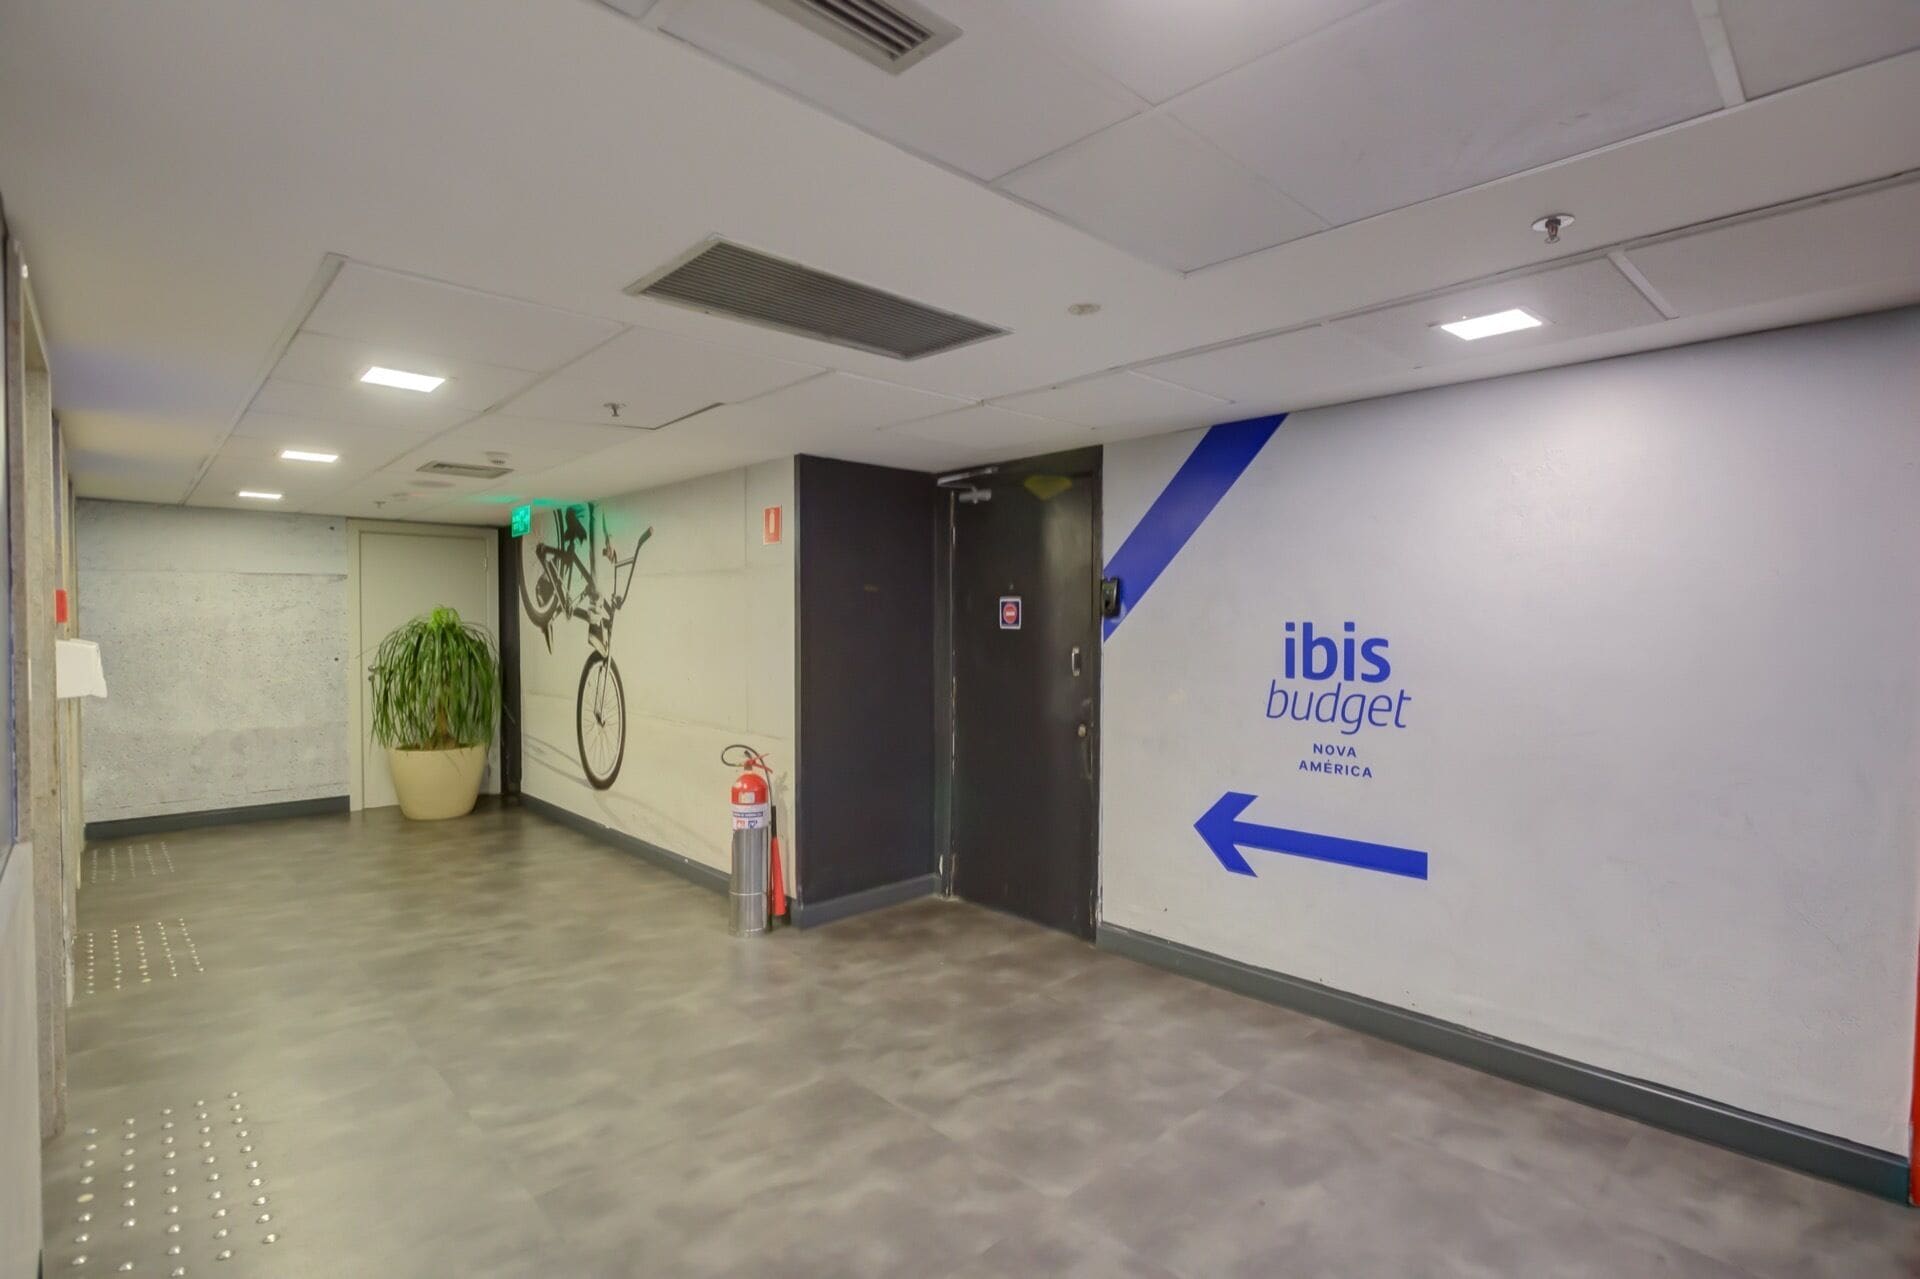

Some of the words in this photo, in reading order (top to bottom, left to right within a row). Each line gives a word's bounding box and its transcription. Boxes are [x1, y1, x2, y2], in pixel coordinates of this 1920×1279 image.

[1285, 621, 1391, 683] ibis
[1265, 679, 1412, 735] budget
[1298, 759, 1373, 778] AMÉRICA
[1313, 743, 1357, 758] NOVA
